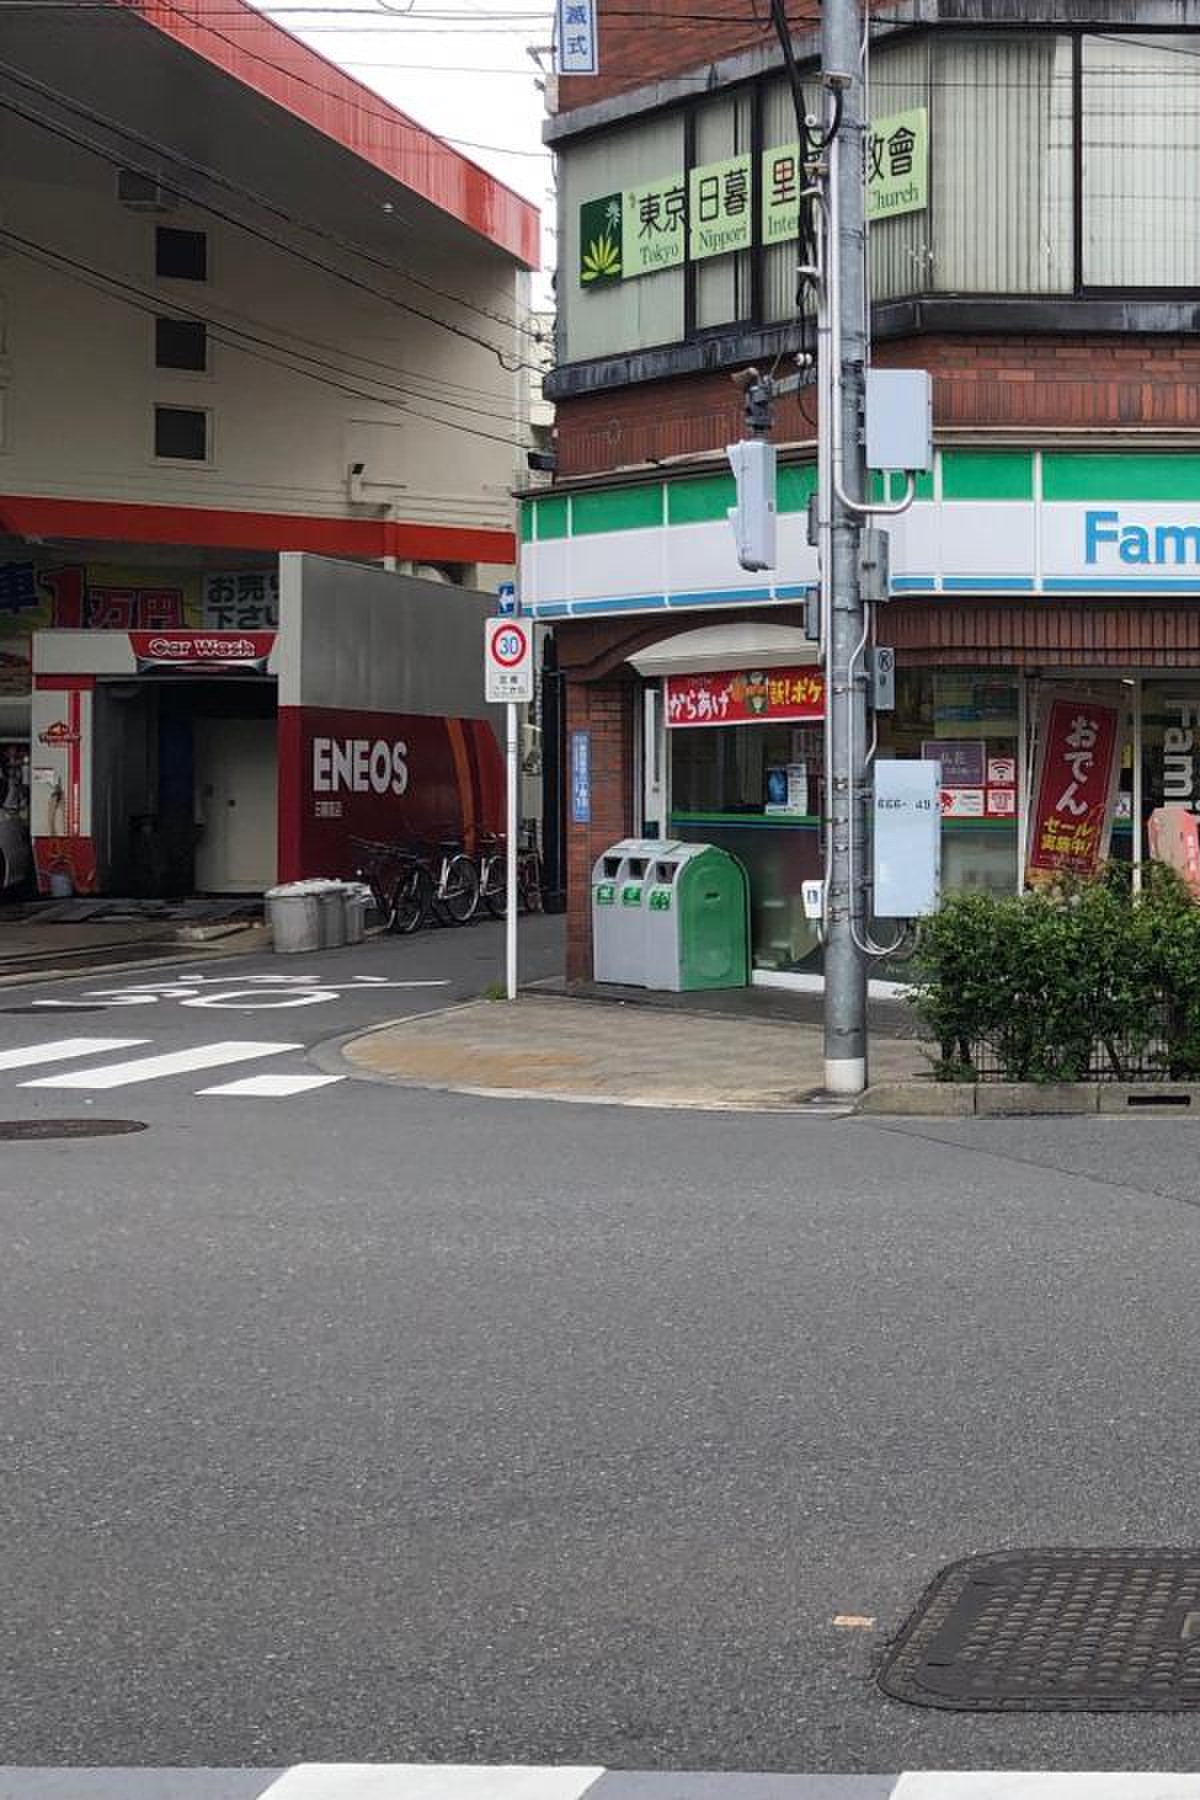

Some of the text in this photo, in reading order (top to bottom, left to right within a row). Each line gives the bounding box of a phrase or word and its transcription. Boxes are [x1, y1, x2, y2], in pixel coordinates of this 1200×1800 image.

[640, 242, 679, 266] Tokyo
[700, 223, 747, 251] Nippori
[149, 638, 256, 657] Car Wash
[500, 633, 519, 656] 30
[670, 688, 730, 720] からあげ
[313, 737, 409, 795] ENEOS
[1055, 715, 1100, 816] おでん
